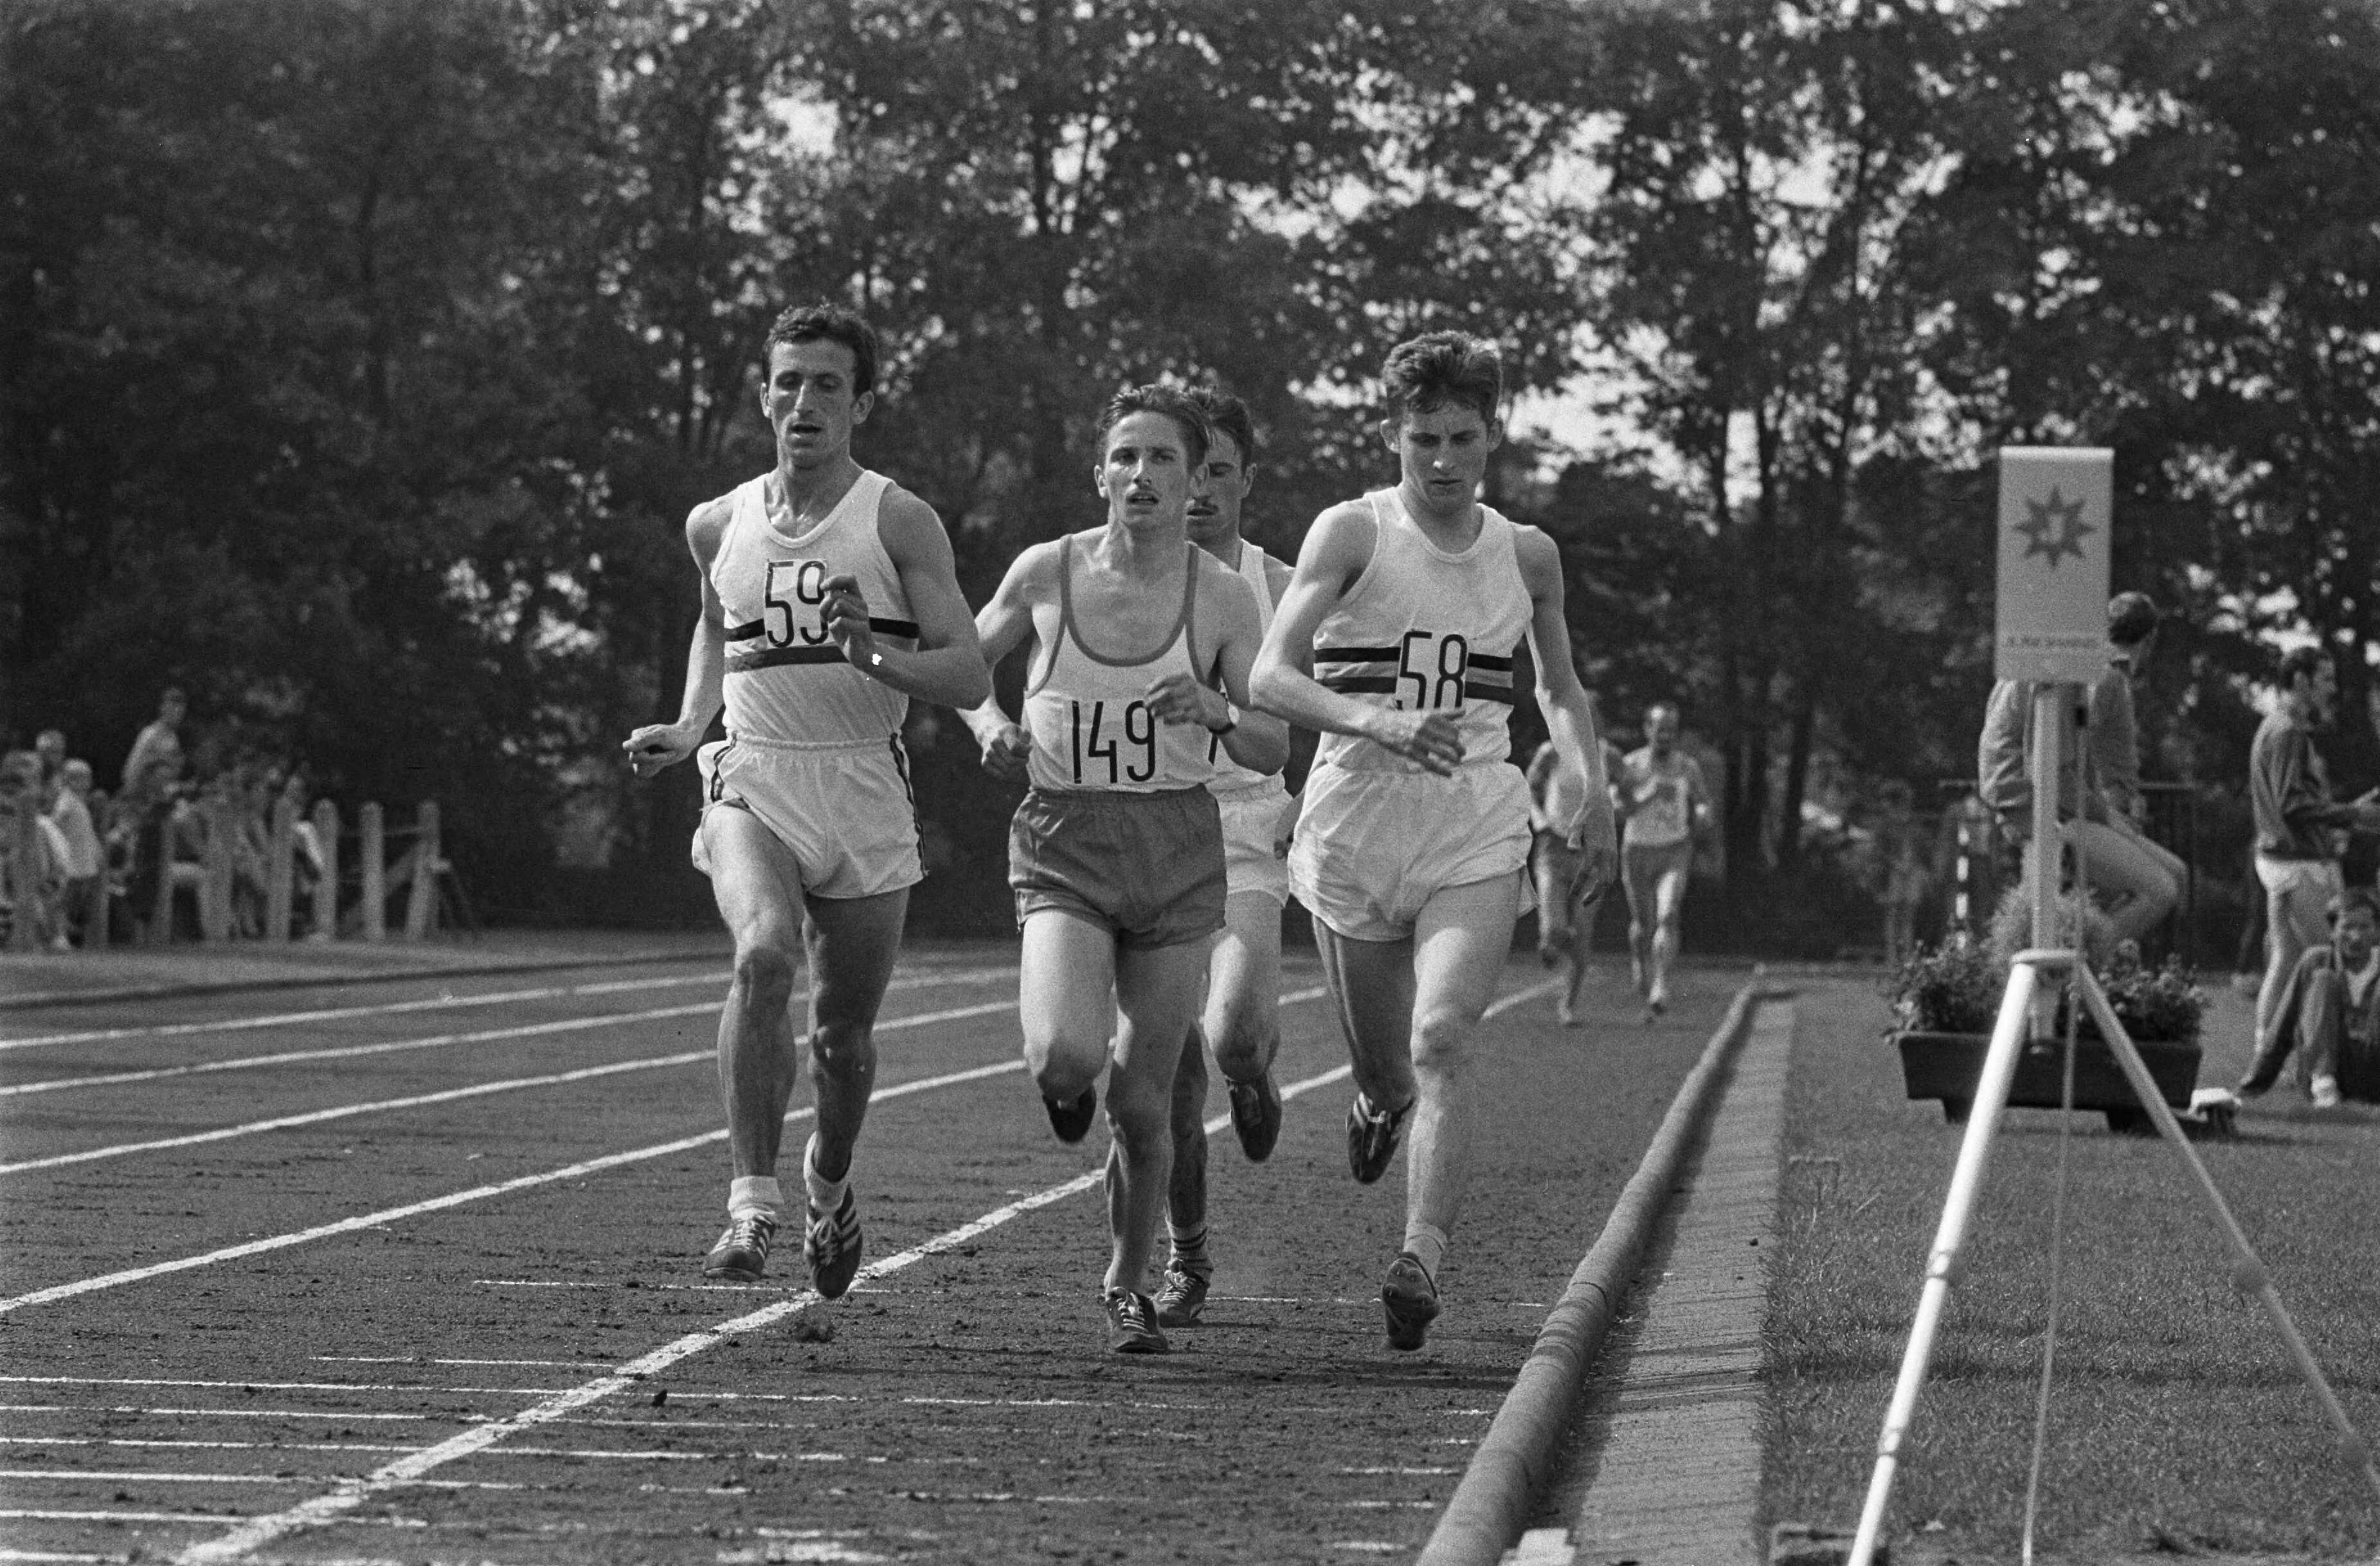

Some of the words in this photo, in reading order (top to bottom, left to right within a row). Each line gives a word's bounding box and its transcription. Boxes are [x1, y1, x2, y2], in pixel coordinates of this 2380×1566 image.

[765, 561, 828, 647] 59
[1395, 631, 1467, 710] 58
[1072, 699, 1156, 784] 149
